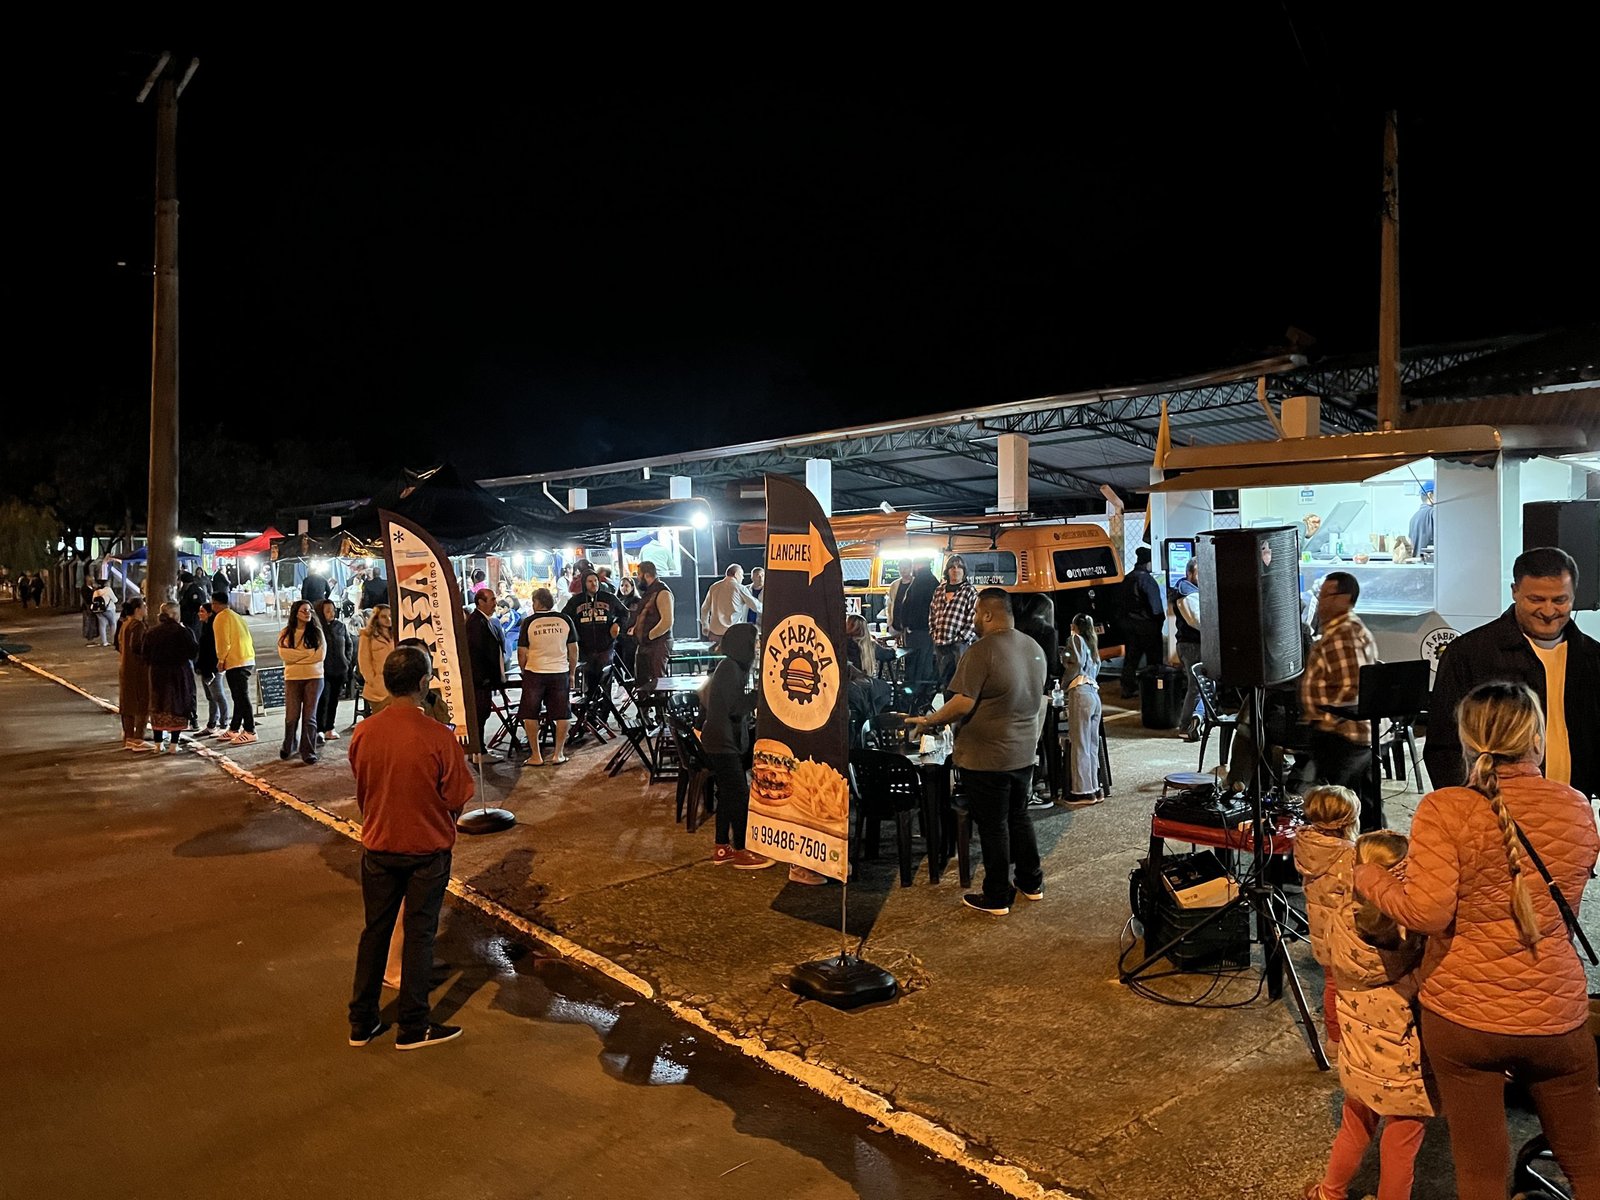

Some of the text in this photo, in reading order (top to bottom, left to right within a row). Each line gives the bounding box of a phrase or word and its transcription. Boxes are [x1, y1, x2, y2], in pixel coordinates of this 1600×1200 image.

[770, 543, 812, 562] LANCHES
[429, 561, 441, 609] máximo
[440, 649, 449, 664] ao
[768, 620, 833, 672] A FÁBRCA
[1425, 631, 1456, 649] A FÁBR
[442, 670, 455, 720] cerveja
[751, 825, 827, 862] 19 99486-7509
